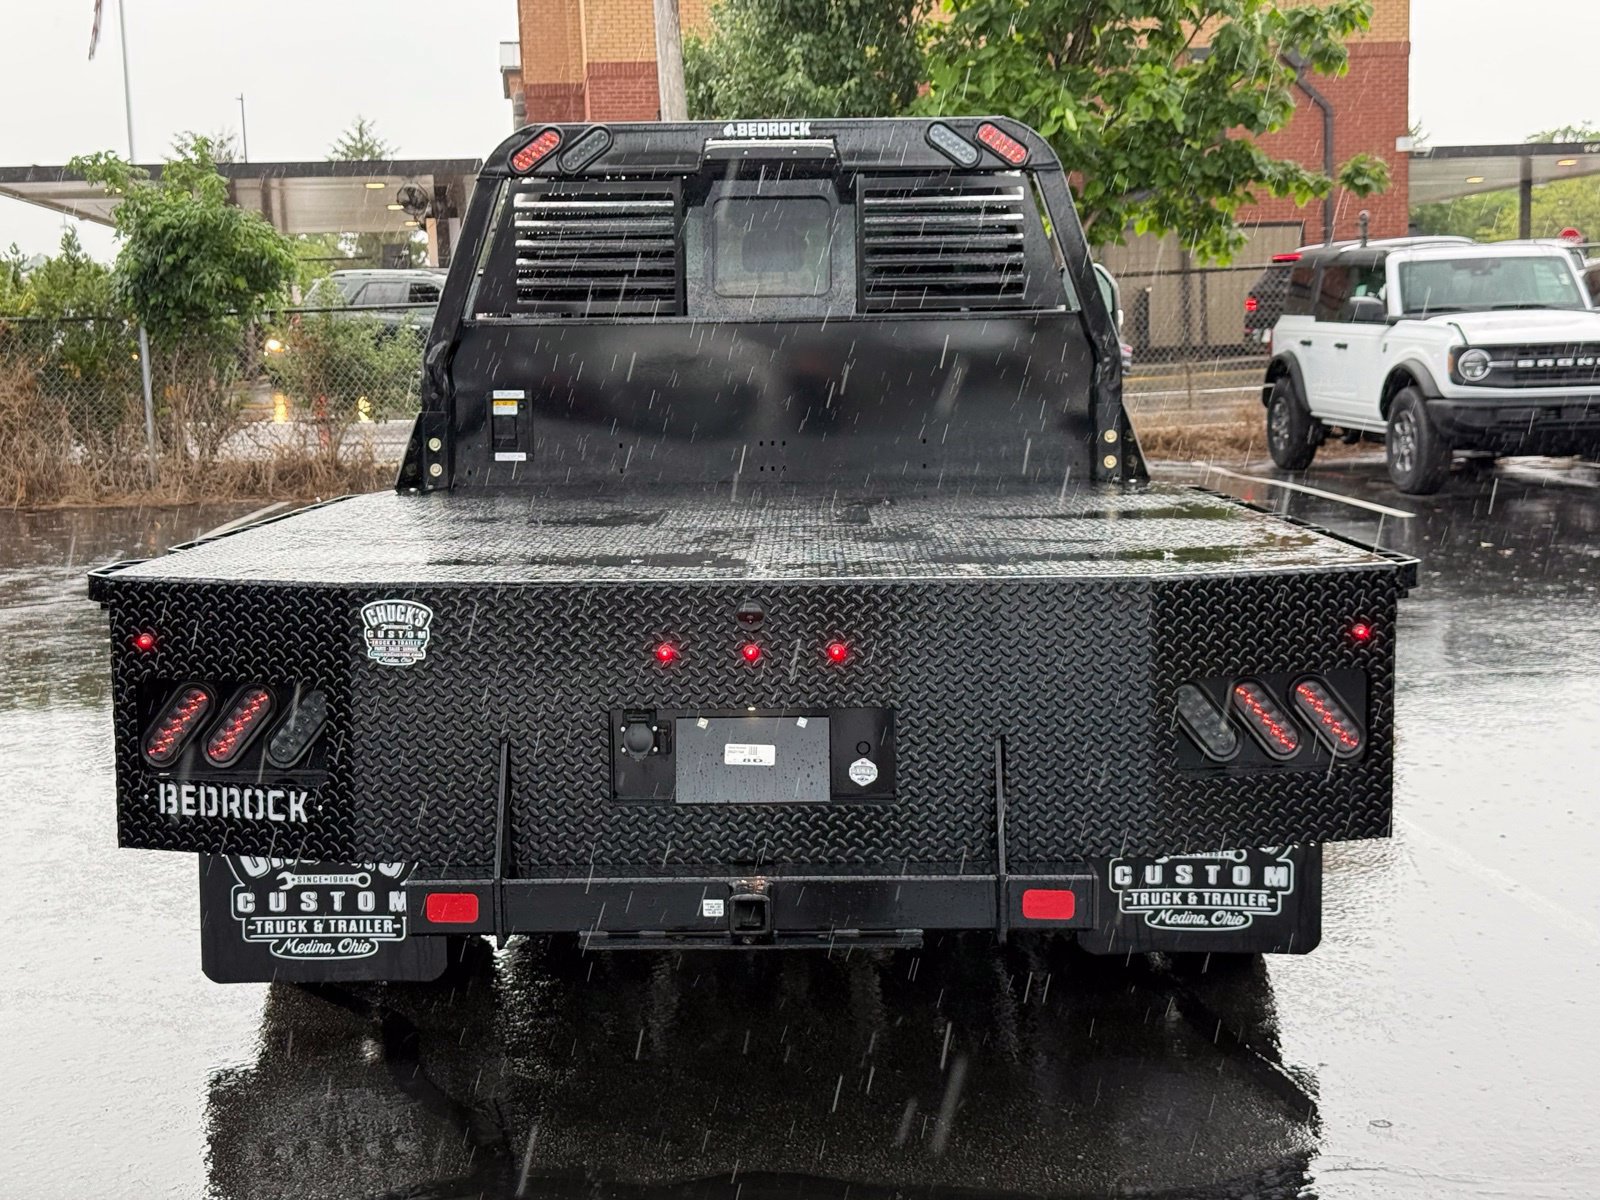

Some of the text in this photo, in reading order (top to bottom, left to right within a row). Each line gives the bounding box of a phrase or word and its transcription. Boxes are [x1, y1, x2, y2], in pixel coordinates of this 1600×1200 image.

[737, 122, 811, 136] BEDROCK
[1517, 357, 1600, 368] BRON
[365, 604, 429, 628] CHUCK'S
[367, 630, 427, 639] CUSTOM
[159, 783, 308, 823] BEDROCK
[297, 875, 350, 884] SINCE 1984
[1114, 864, 1289, 888] CUSTOM
[236, 890, 407, 913] CUSTOM
[1131, 892, 1269, 907] TRUCK & TRAILER
[1151, 909, 1246, 926] Medina, Ohio
[255, 919, 394, 934] TRUCK & TRAILER
[276, 937, 372, 955] Medina, Ohio
